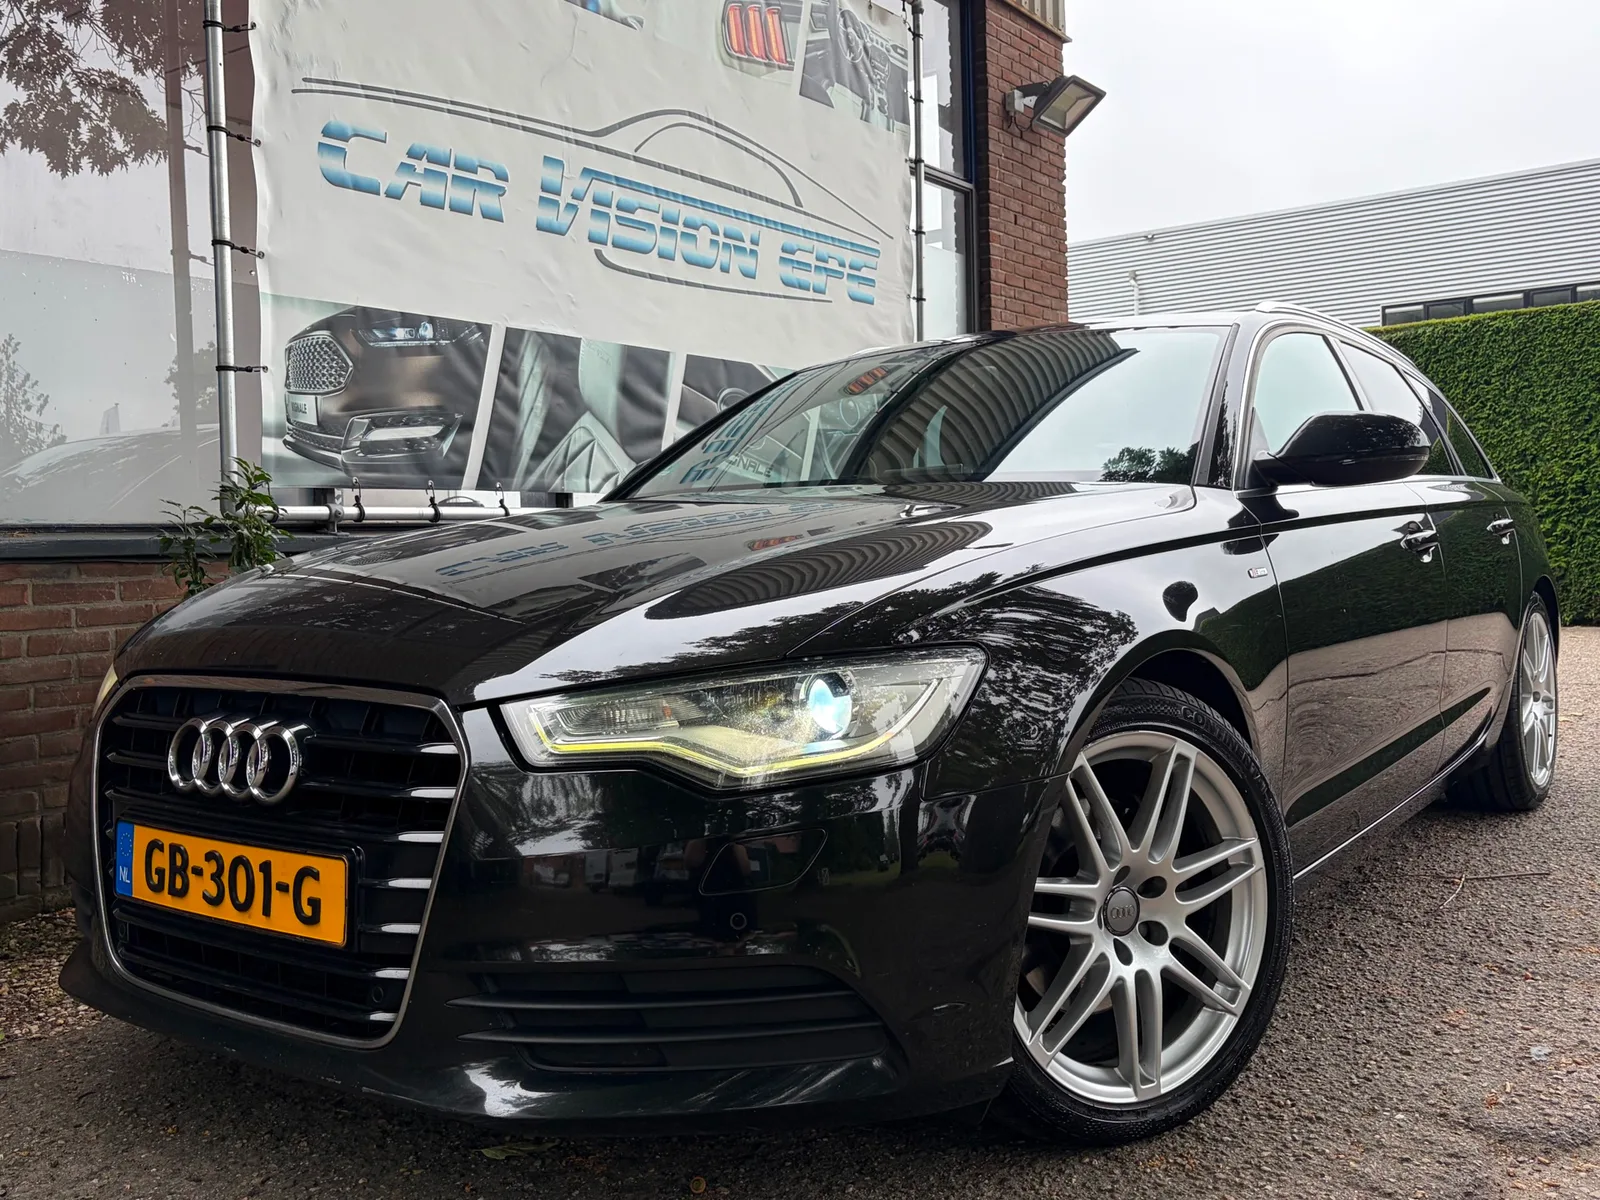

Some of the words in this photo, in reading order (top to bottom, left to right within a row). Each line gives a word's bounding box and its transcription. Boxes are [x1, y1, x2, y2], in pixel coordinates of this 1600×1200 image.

[317, 120, 509, 223] CAR
[535, 155, 762, 279] VISION
[778, 240, 878, 305] EPE
[119, 865, 131, 884] NL
[144, 838, 322, 926] GB-301-G
